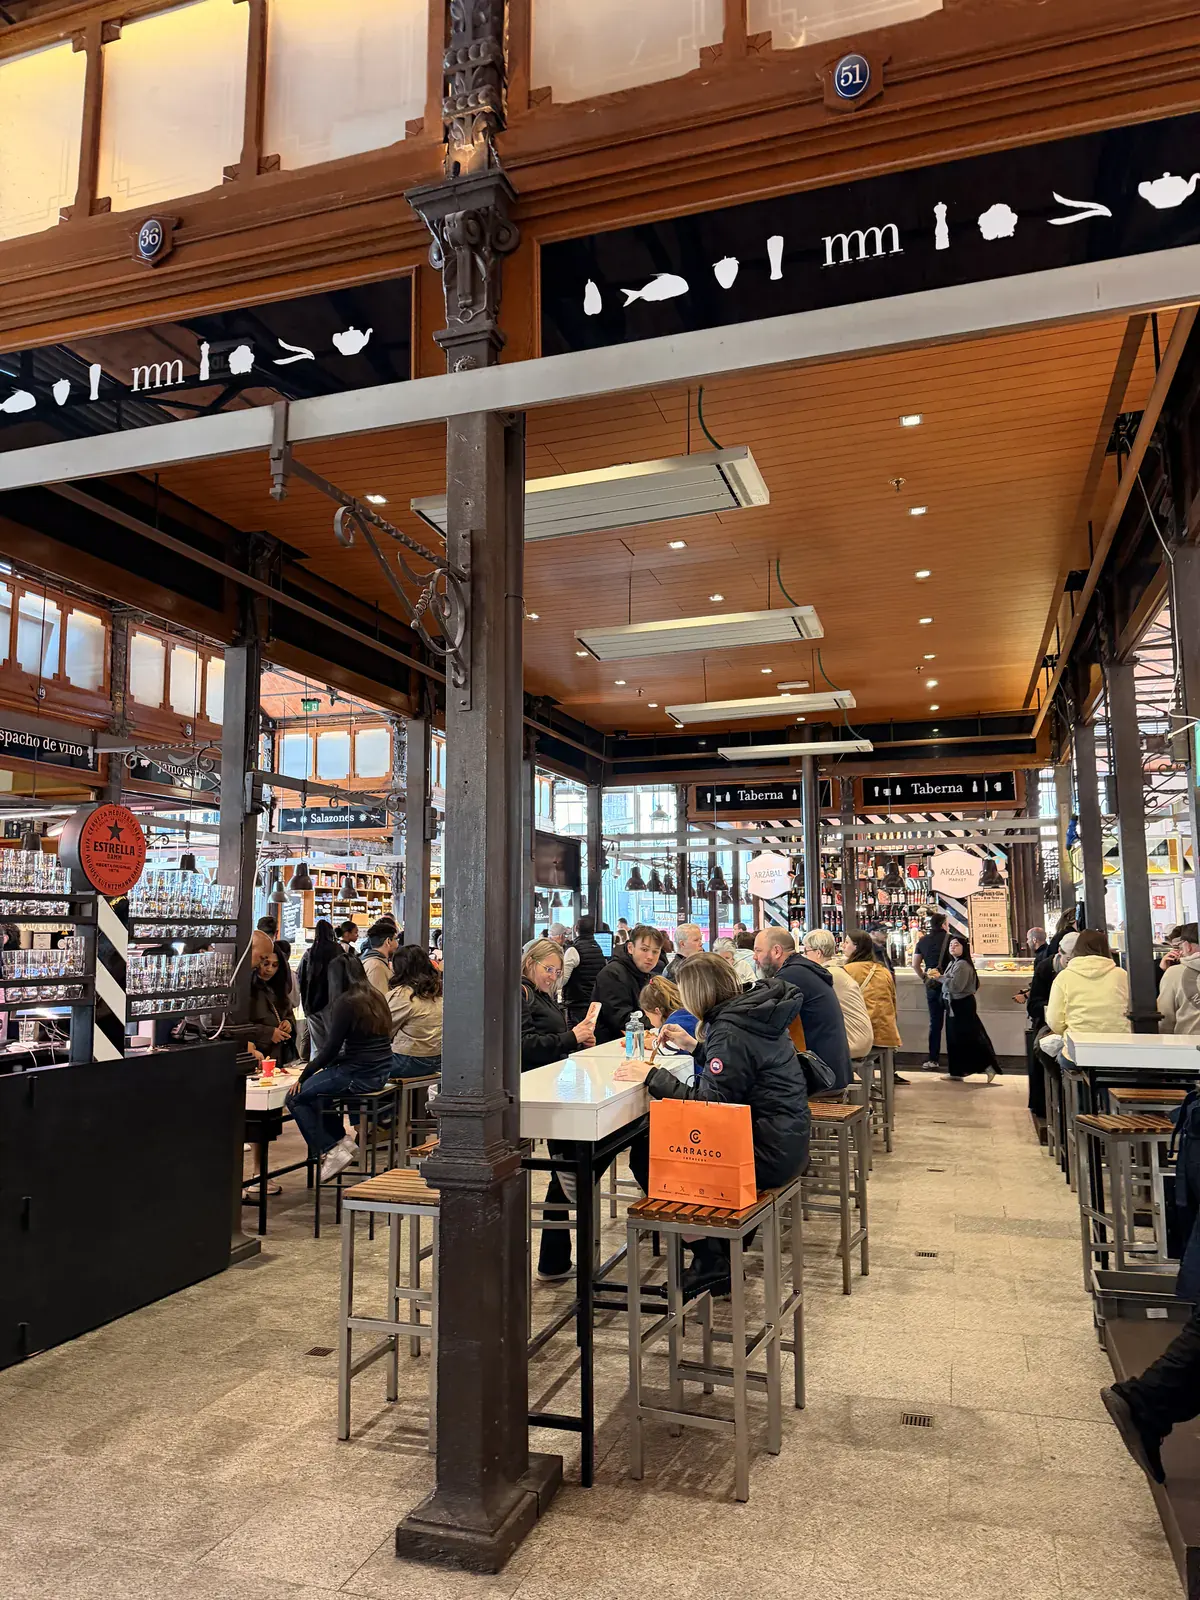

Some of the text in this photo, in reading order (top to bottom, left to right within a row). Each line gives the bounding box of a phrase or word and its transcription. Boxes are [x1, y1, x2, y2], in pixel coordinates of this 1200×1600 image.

[840, 64, 863, 87] 51
[141, 227, 160, 247] 36
[42, 737, 57, 752] de
[58, 742, 83, 757] vino
[737, 789, 784, 801] Taberna
[911, 782, 964, 795] Taberna
[310, 813, 355, 824] Salazones
[93, 841, 135, 856] ESTRELLA
[106, 853, 122, 861] DAMM
[754, 868, 783, 879] ARZÁBAL
[940, 866, 975, 876] ARZÁBAL
[668, 1145, 722, 1159] CARRASCO
